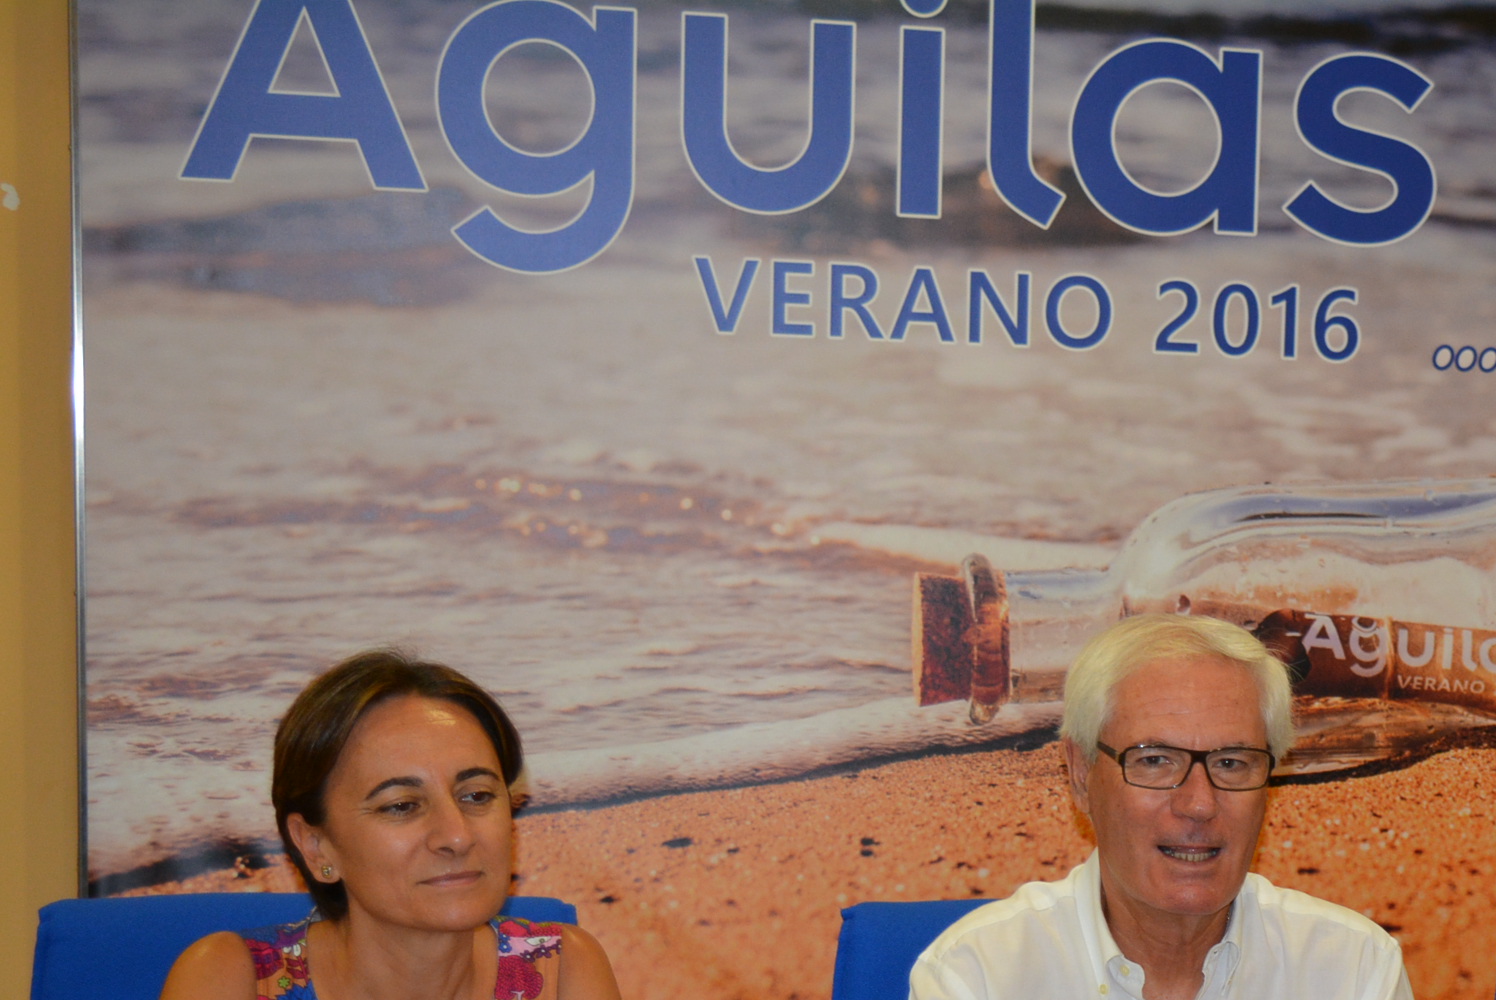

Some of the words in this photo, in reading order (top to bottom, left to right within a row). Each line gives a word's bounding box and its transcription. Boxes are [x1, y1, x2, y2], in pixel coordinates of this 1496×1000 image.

[694, 257, 1113, 349] VERANO
[1153, 280, 1361, 362] 2016
[1396, 674, 1485, 695] VERANO
